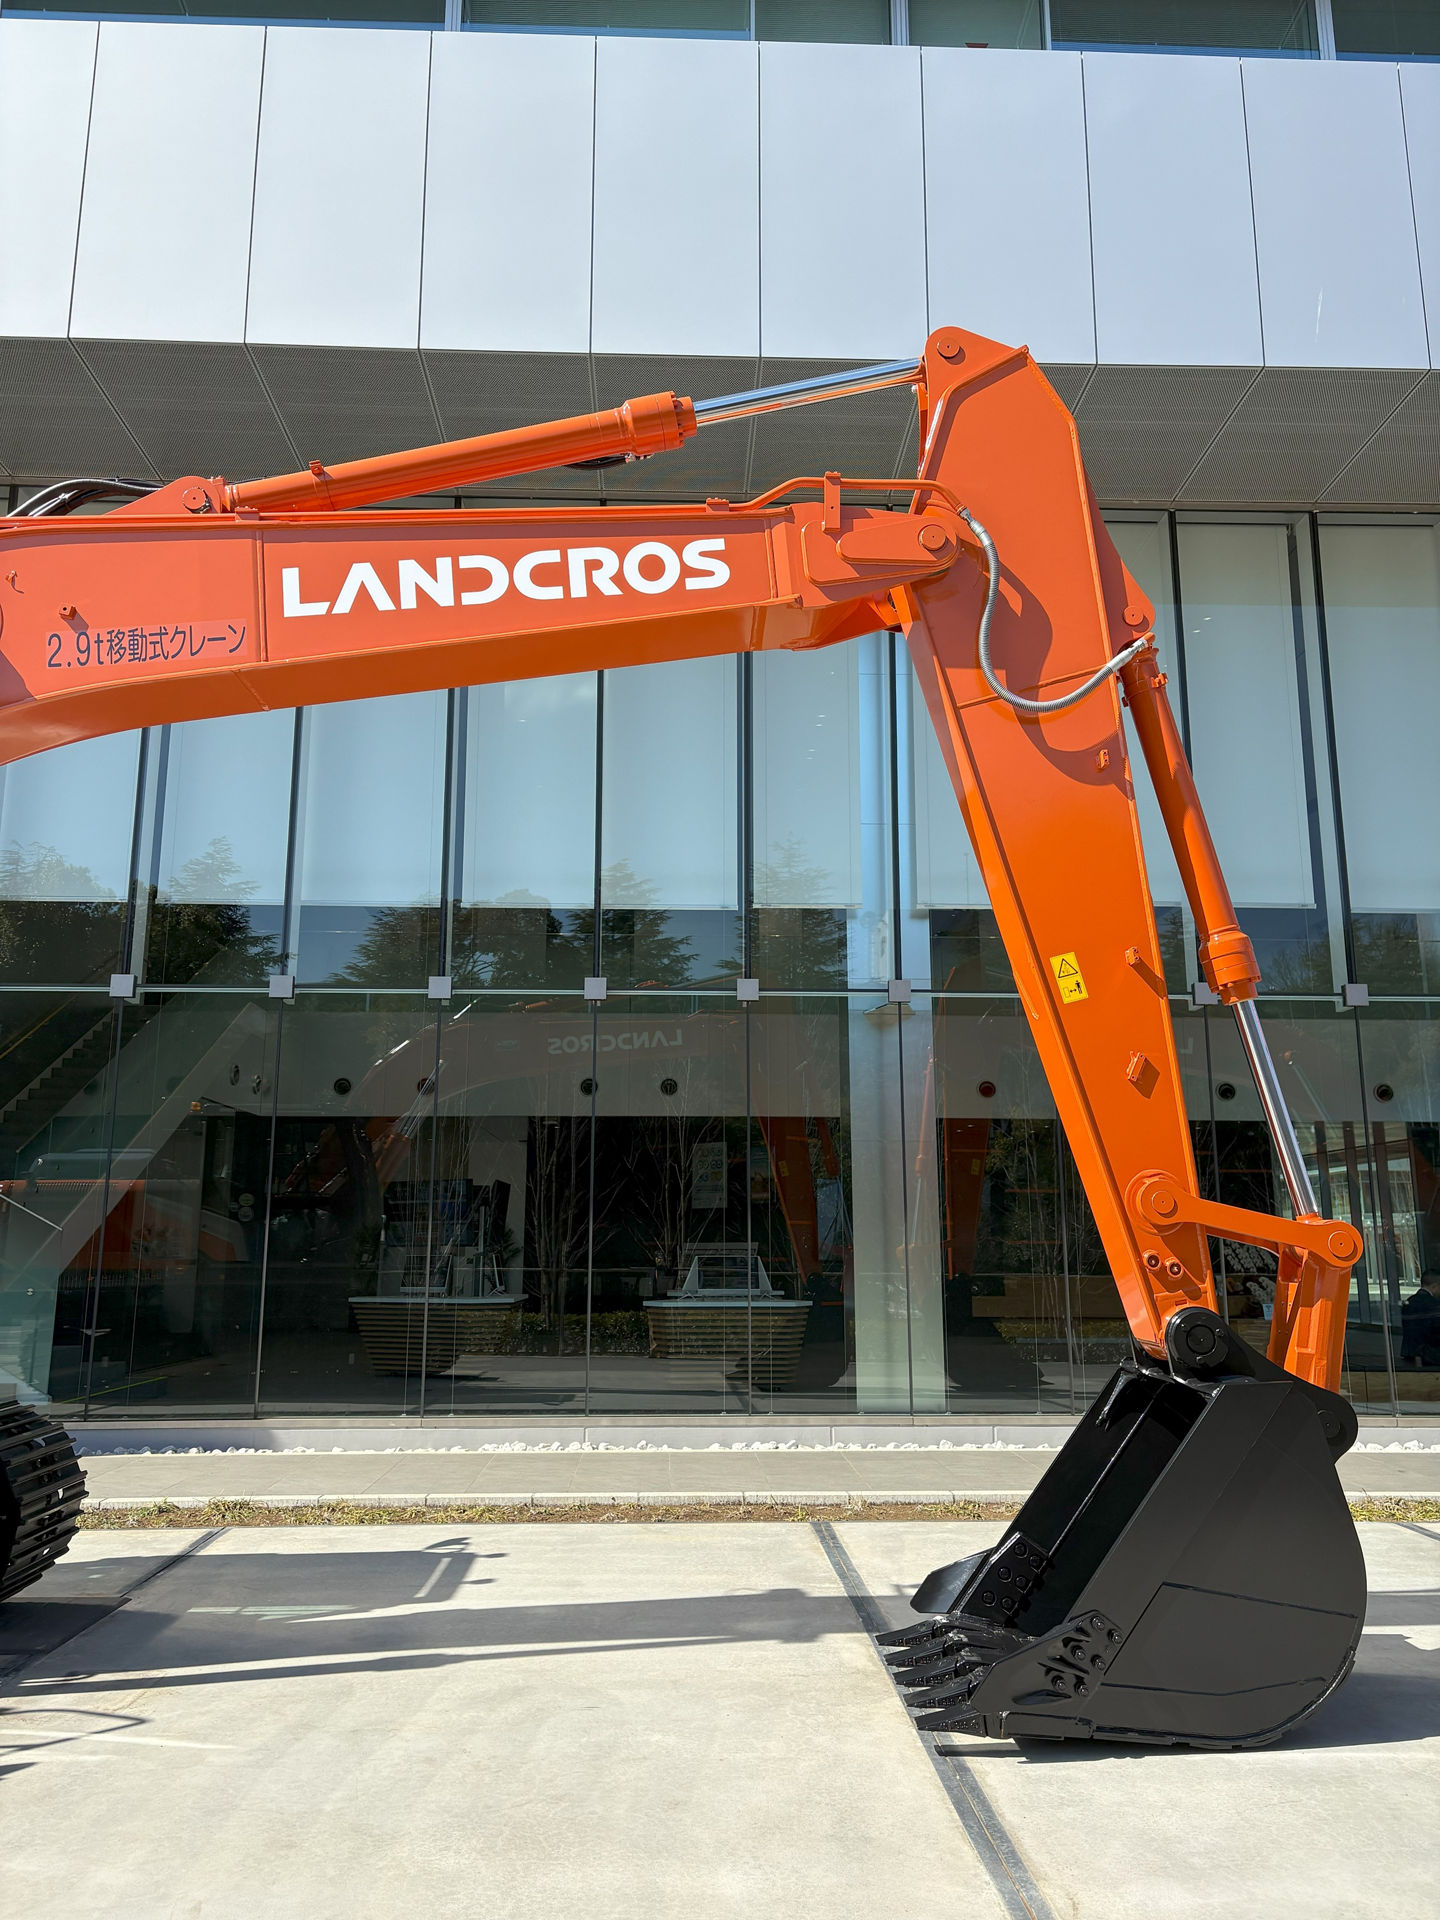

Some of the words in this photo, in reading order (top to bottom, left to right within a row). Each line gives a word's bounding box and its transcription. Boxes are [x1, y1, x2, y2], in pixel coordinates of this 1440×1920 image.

[282, 538, 731, 618] LANDCROS
[47, 624, 246, 668] 2.9t移動式クレーン
